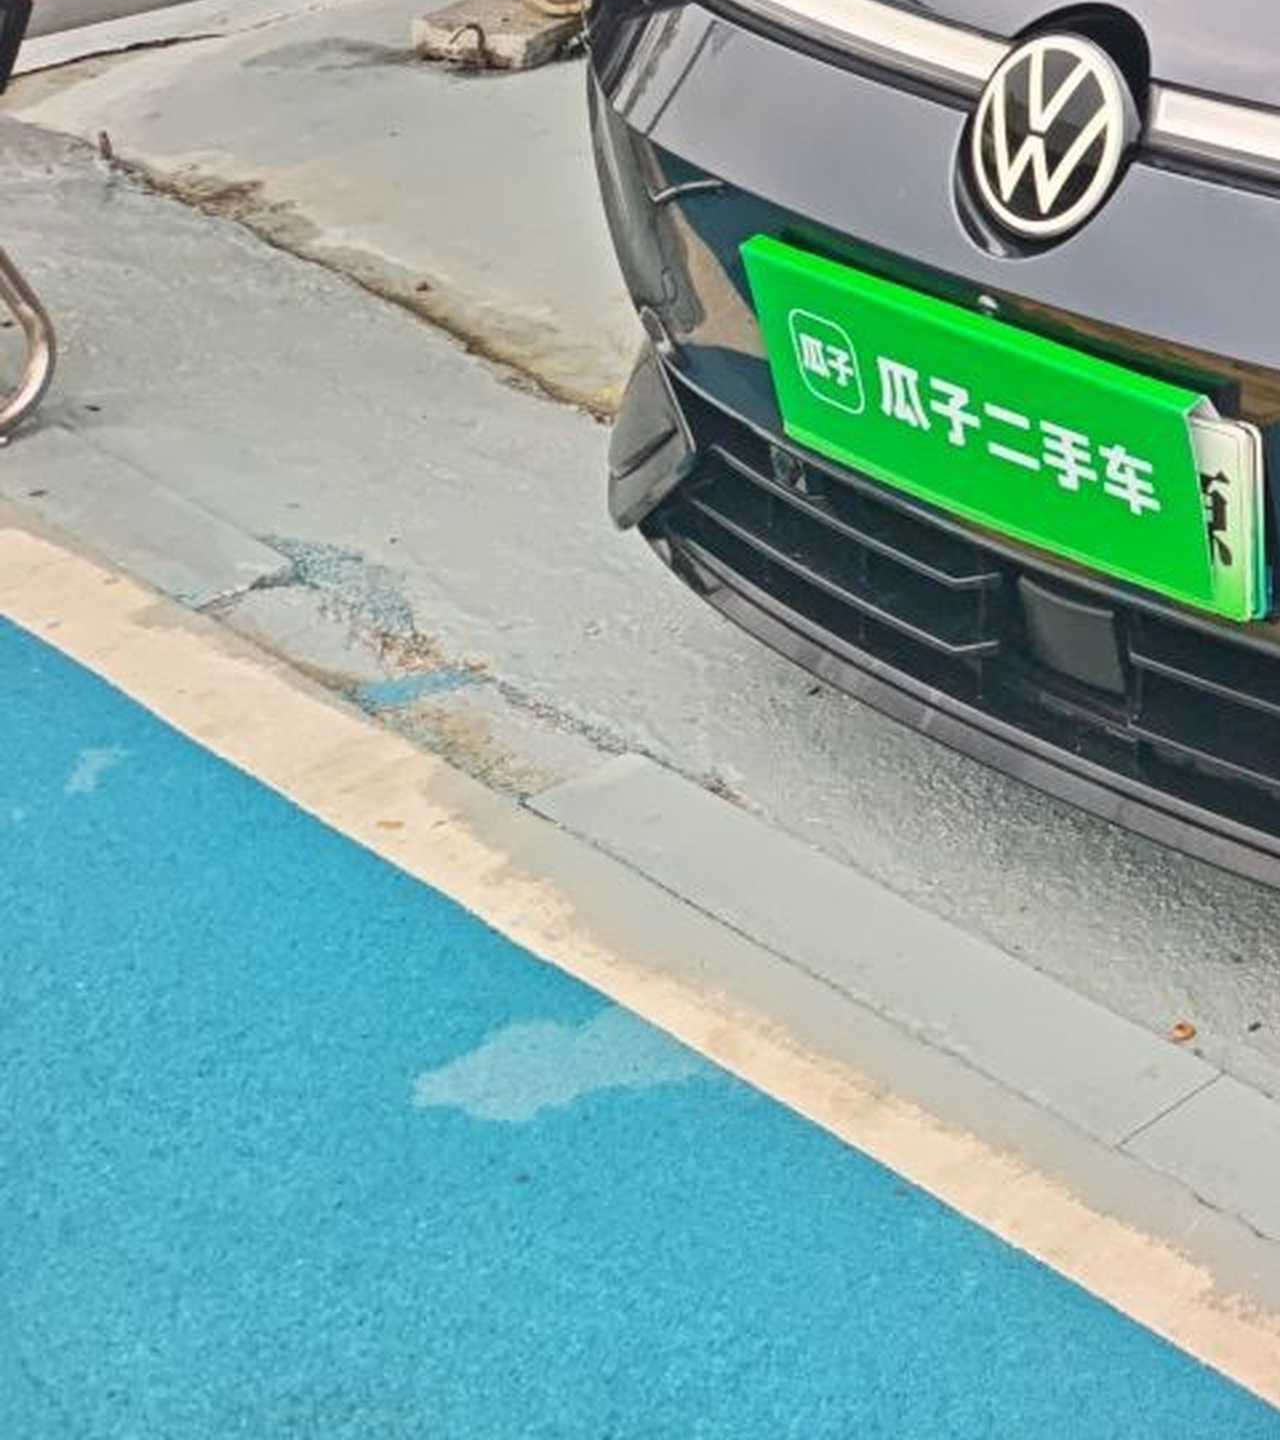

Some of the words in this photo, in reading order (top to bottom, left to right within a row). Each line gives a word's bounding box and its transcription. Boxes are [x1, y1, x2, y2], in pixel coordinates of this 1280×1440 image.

[799, 332, 854, 387] 瓜子
[876, 355, 1161, 515] 瓜子二手车
